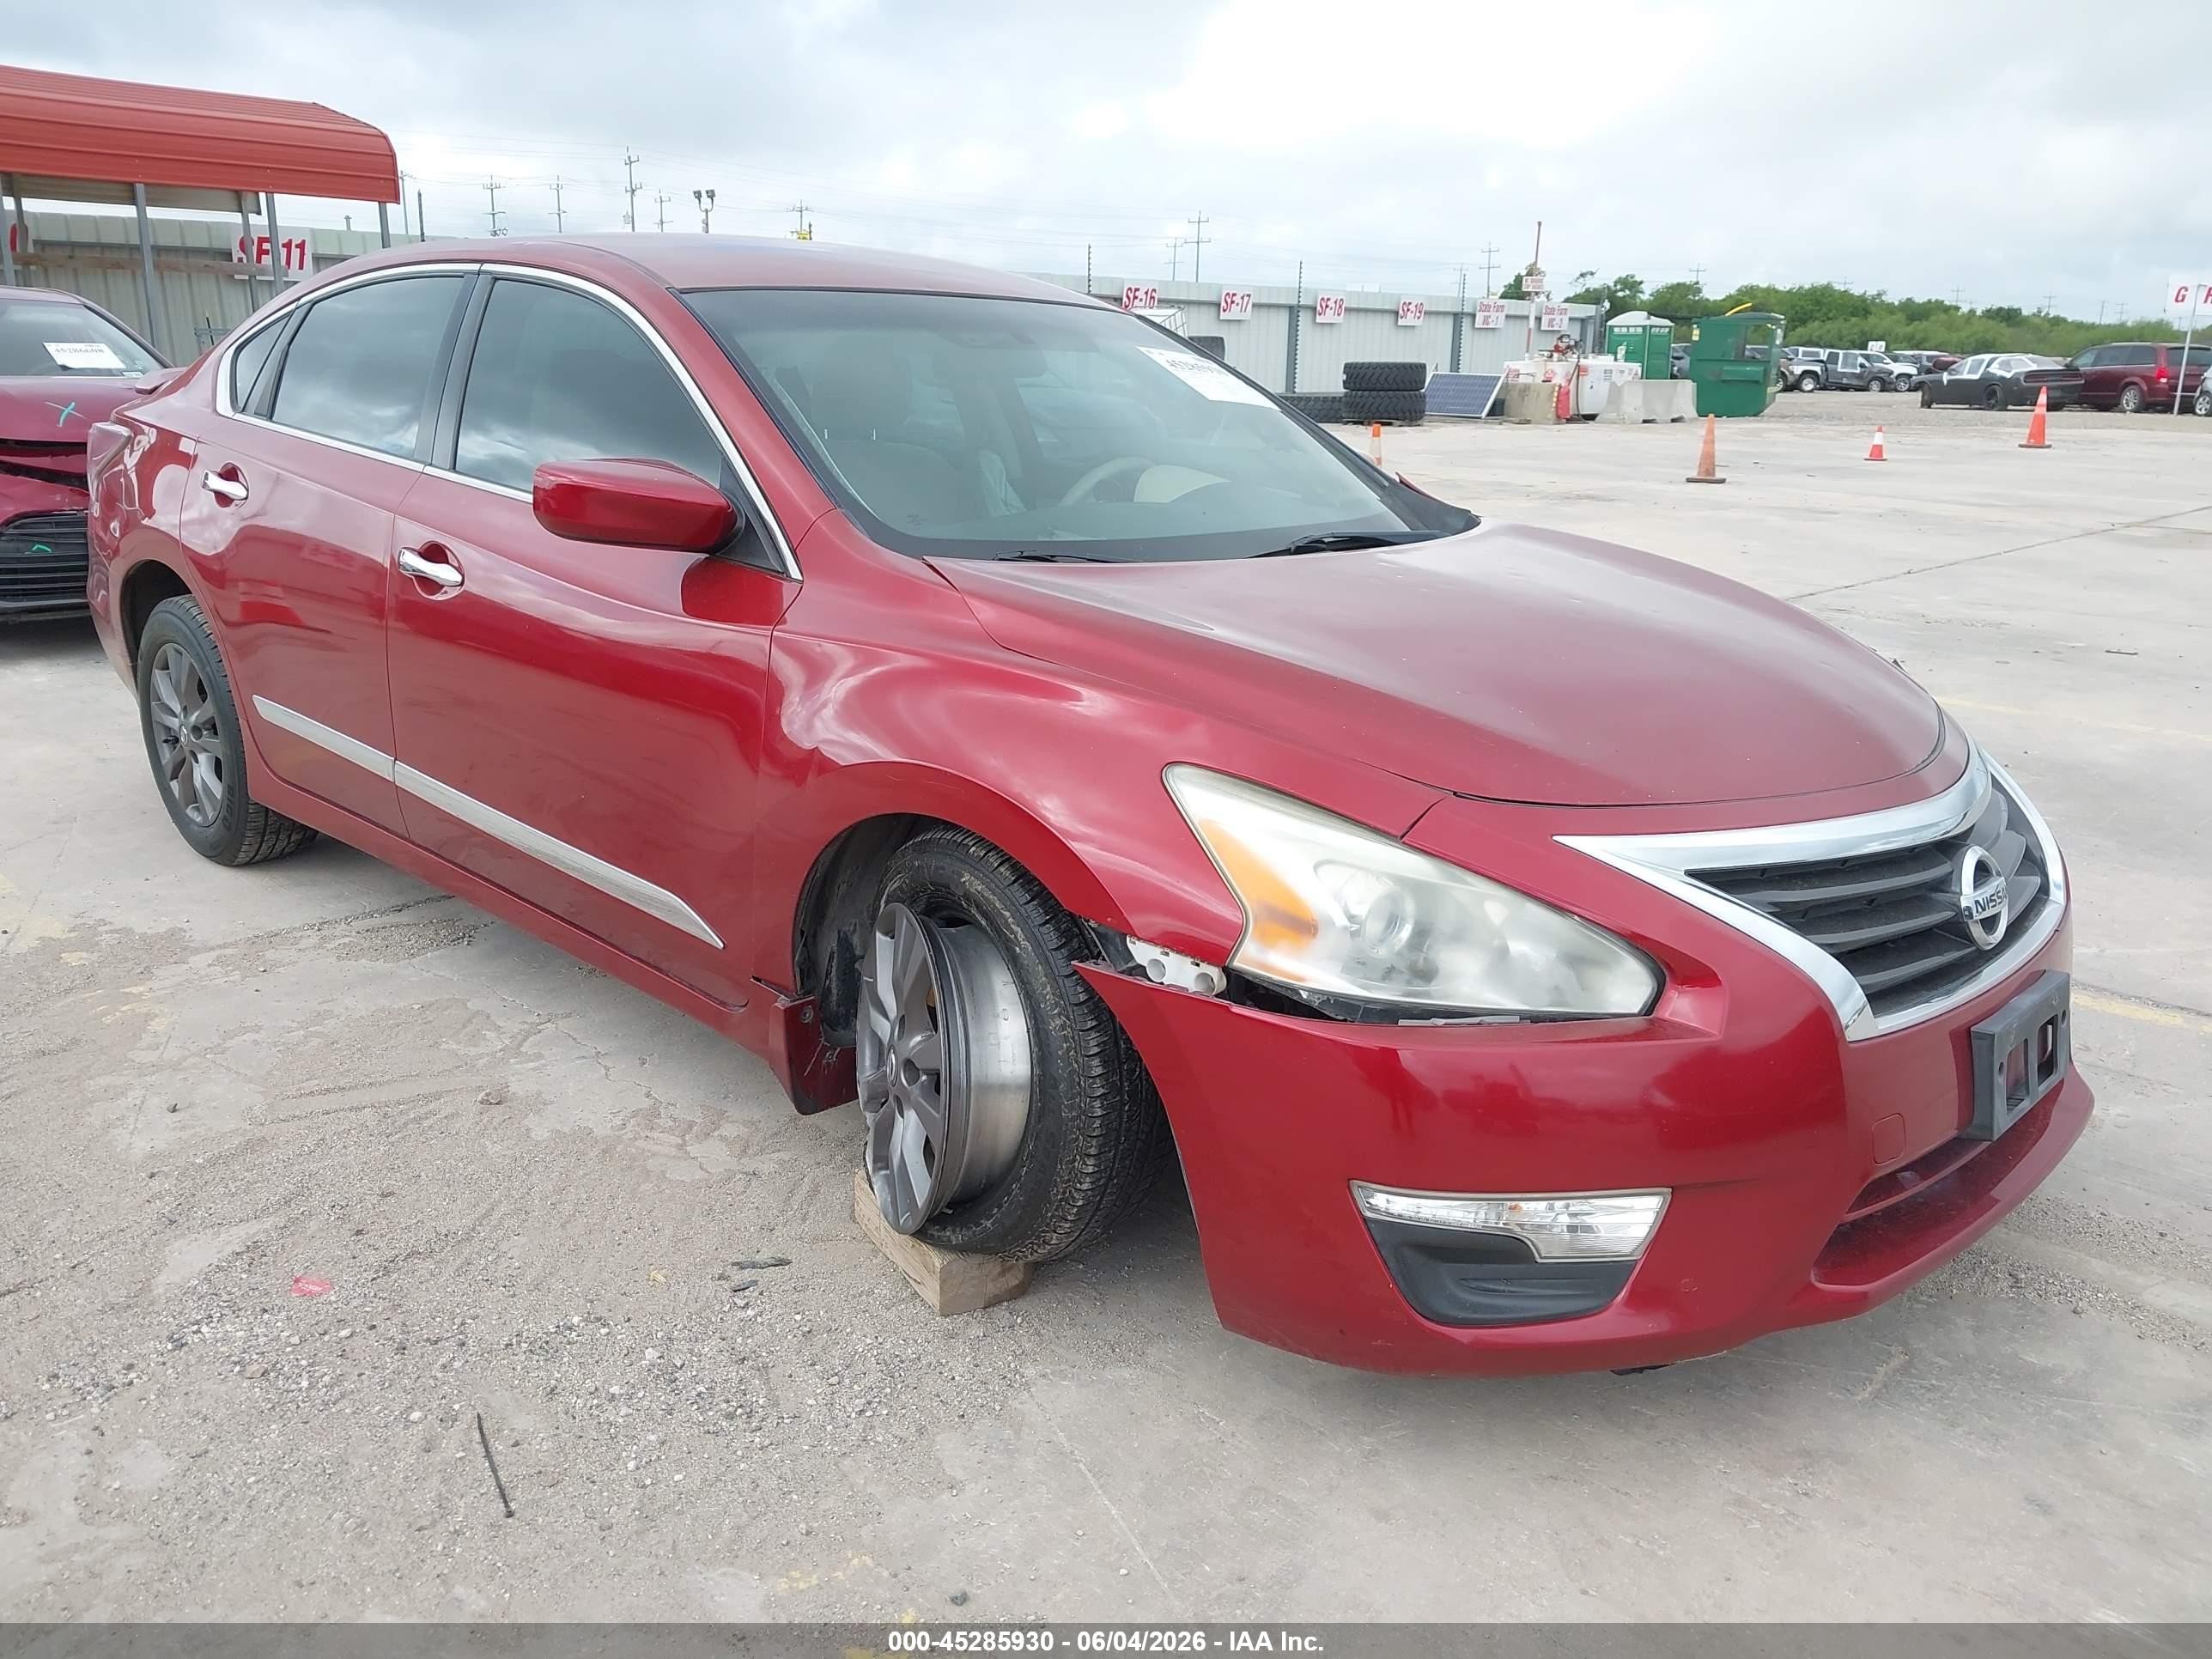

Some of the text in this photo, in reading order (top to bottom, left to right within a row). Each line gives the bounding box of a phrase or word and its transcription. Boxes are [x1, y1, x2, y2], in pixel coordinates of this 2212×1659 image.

[1123, 286, 1158, 310] SF-16
[1222, 291, 1252, 313] SF-17
[2174, 285, 2189, 303] G
[1318, 296, 1345, 317] SF-18
[1400, 301, 1424, 320] SF-19
[1478, 301, 1505, 313] State Farm
[1544, 305, 1568, 316] State Farm
